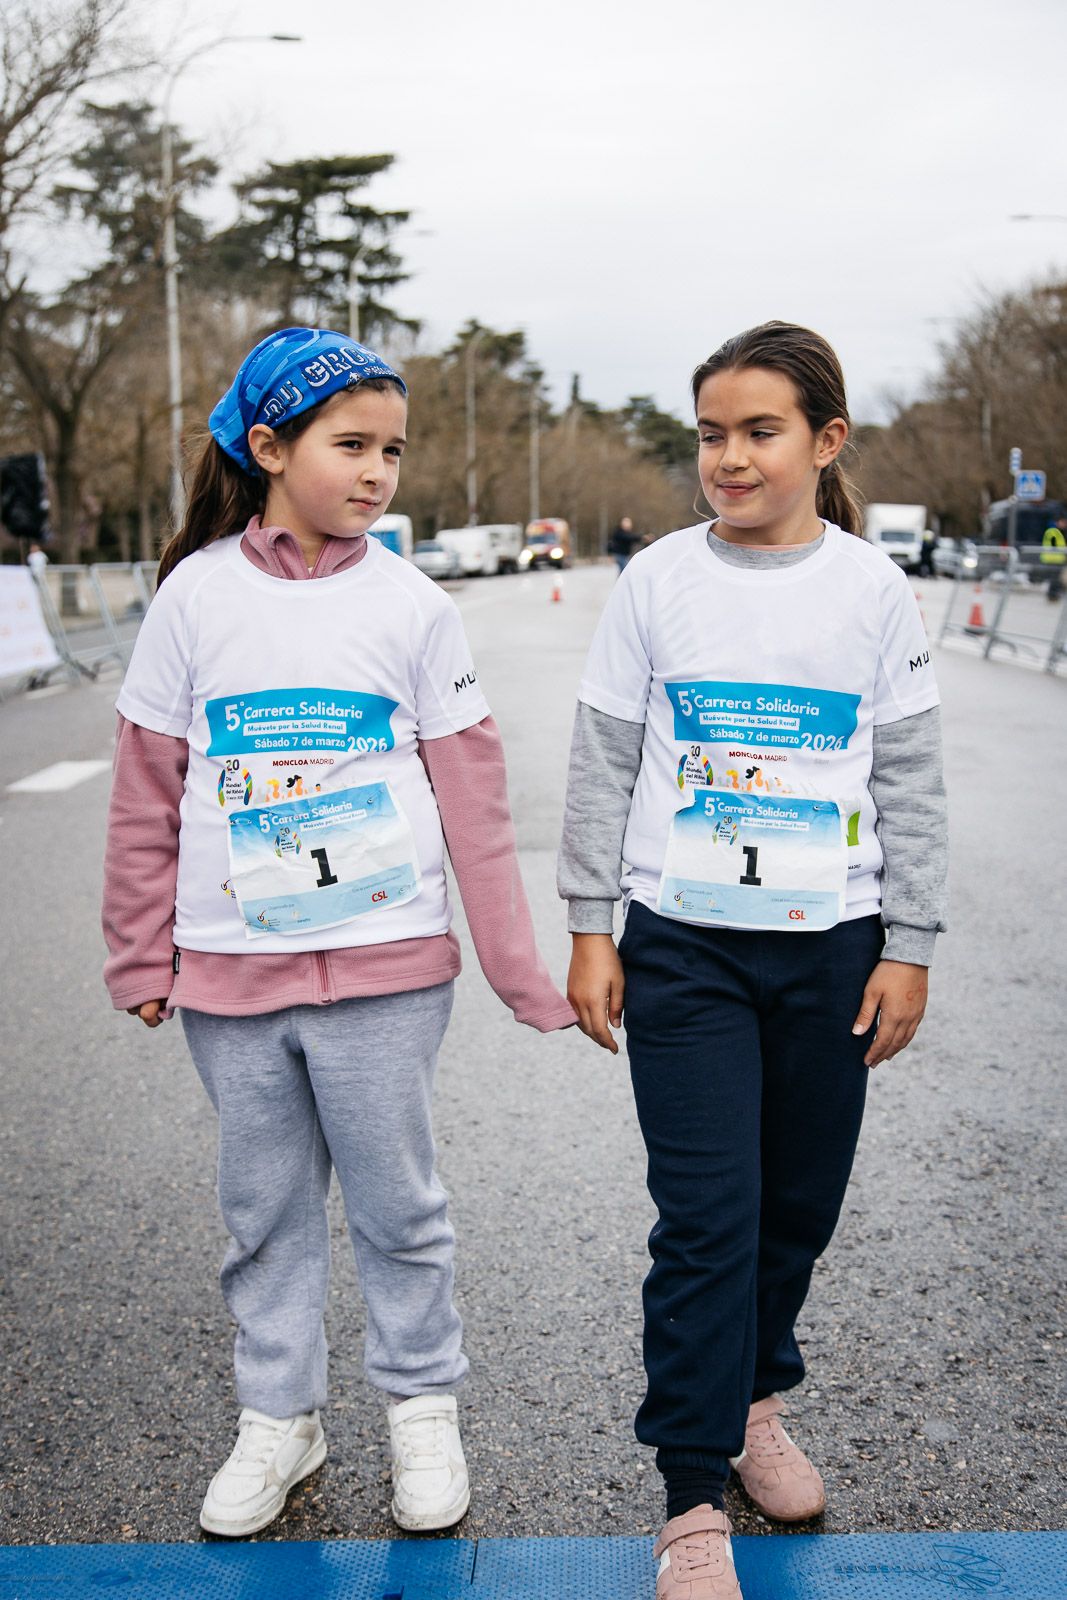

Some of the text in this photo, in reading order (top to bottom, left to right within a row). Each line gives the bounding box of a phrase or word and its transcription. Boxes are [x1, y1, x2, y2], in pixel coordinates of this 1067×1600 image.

[244, 706, 294, 720] Carrera
[300, 702, 363, 719] Solidaria
[694, 695, 751, 710] Carrera
[756, 697, 820, 715] Solidaria
[248, 724, 277, 732] Muévete
[324, 723, 343, 731] Renal
[702, 714, 732, 722] Muévete
[734, 716, 746, 724] por
[757, 717, 777, 725] Salud
[779, 719, 797, 727] Renal
[254, 735, 387, 752] Sábado 7 de marzo 2026
[709, 729, 845, 751] Sábado 7 de marzo 2026
[729, 751, 763, 760] MONCLOA
[226, 759, 240, 771] 20
[272, 812, 309, 826] Carrera
[312, 802, 352, 817] Solidaria
[718, 803, 754, 817] Carrera
[756, 806, 798, 818] Solidaria
[310, 848, 338, 888] 1
[740, 846, 761, 886] 1
[371, 891, 388, 903] CSL
[789, 910, 806, 920] CSL
